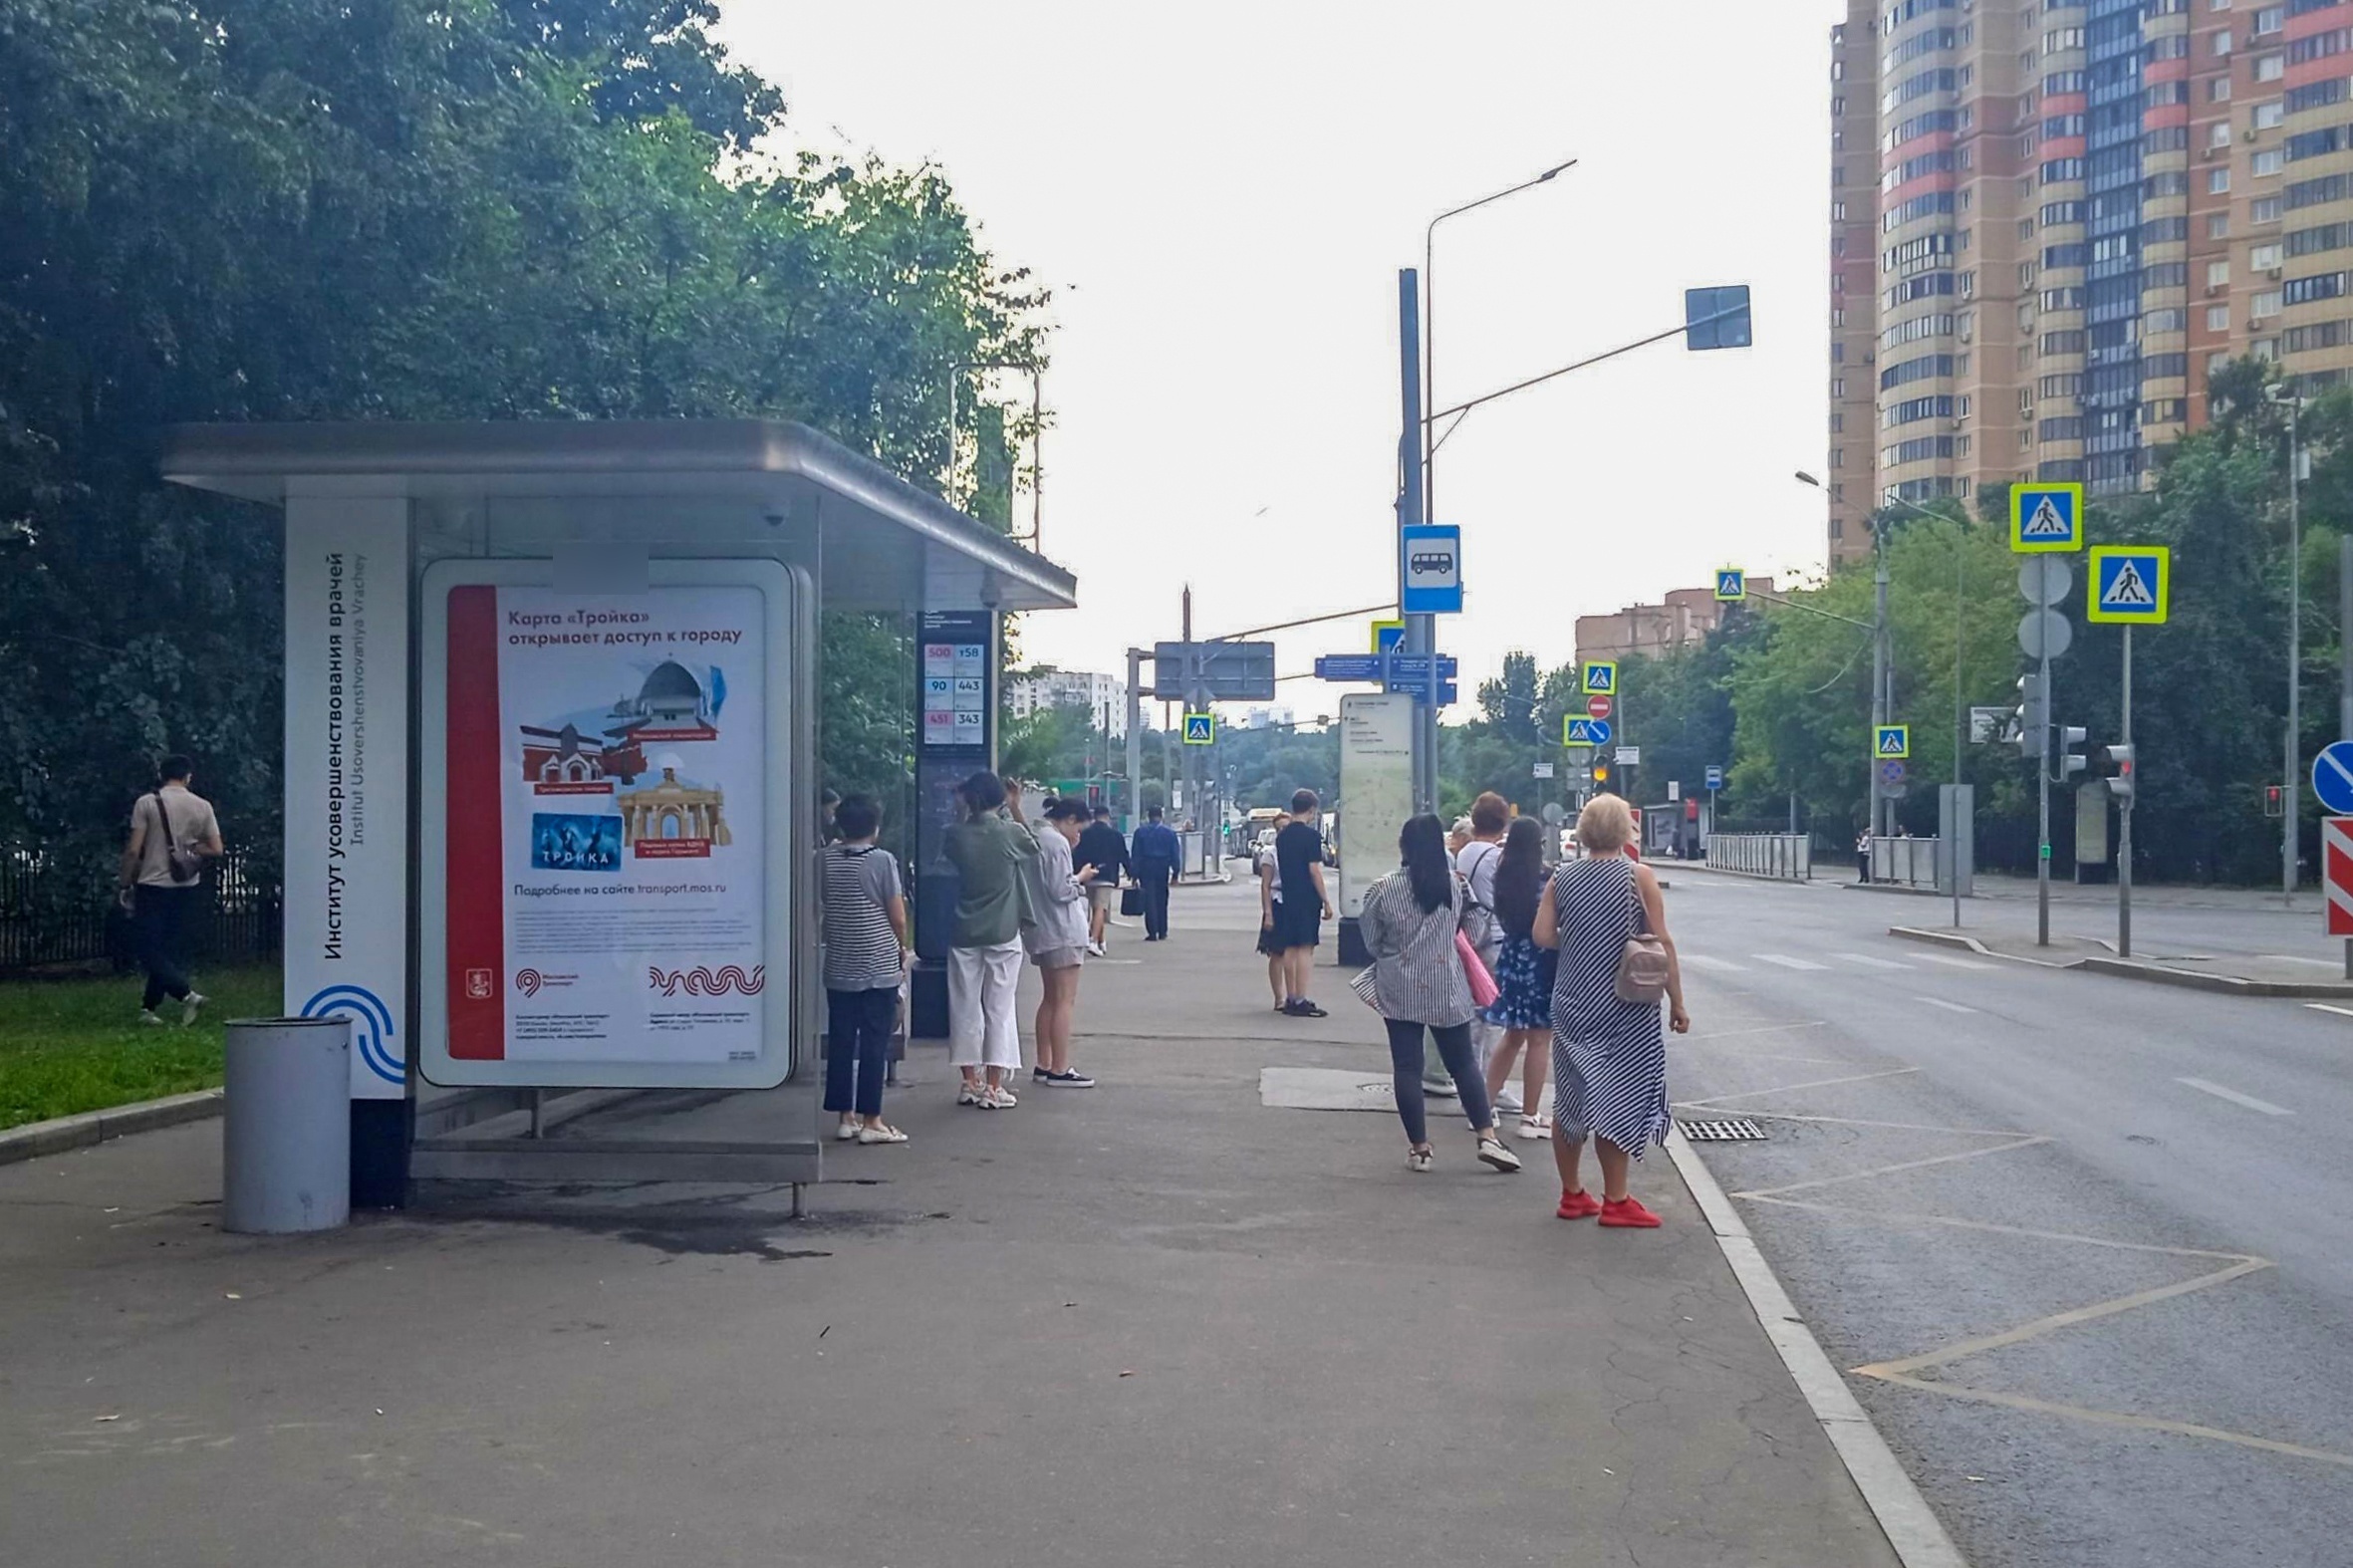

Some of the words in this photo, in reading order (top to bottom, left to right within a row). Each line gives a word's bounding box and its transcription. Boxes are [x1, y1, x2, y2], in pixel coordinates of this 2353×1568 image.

[326, 553, 346, 627] врачей
[352, 554, 368, 615] Vrachey
[508, 611, 561, 629] Карта
[567, 610, 650, 630] «Тройка»
[508, 633, 599, 647] открывает
[604, 631, 661, 646] доступ
[666, 632, 676, 642] к
[681, 629, 742, 645] городу
[928, 648, 950, 657] 500
[931, 681, 946, 690] 90
[958, 681, 979, 690] 443
[351, 619, 367, 785] Usovershenstvovaniya
[929, 714, 948, 724] 451
[958, 714, 979, 724] 343
[329, 635, 346, 859] усовершенствования
[351, 787, 364, 846] Institut
[514, 883, 580, 898] Подробнее
[584, 886, 598, 895] на
[602, 885, 635, 895] сайте
[638, 884, 726, 896] transport.mos.ru
[325, 864, 346, 959] Институт
